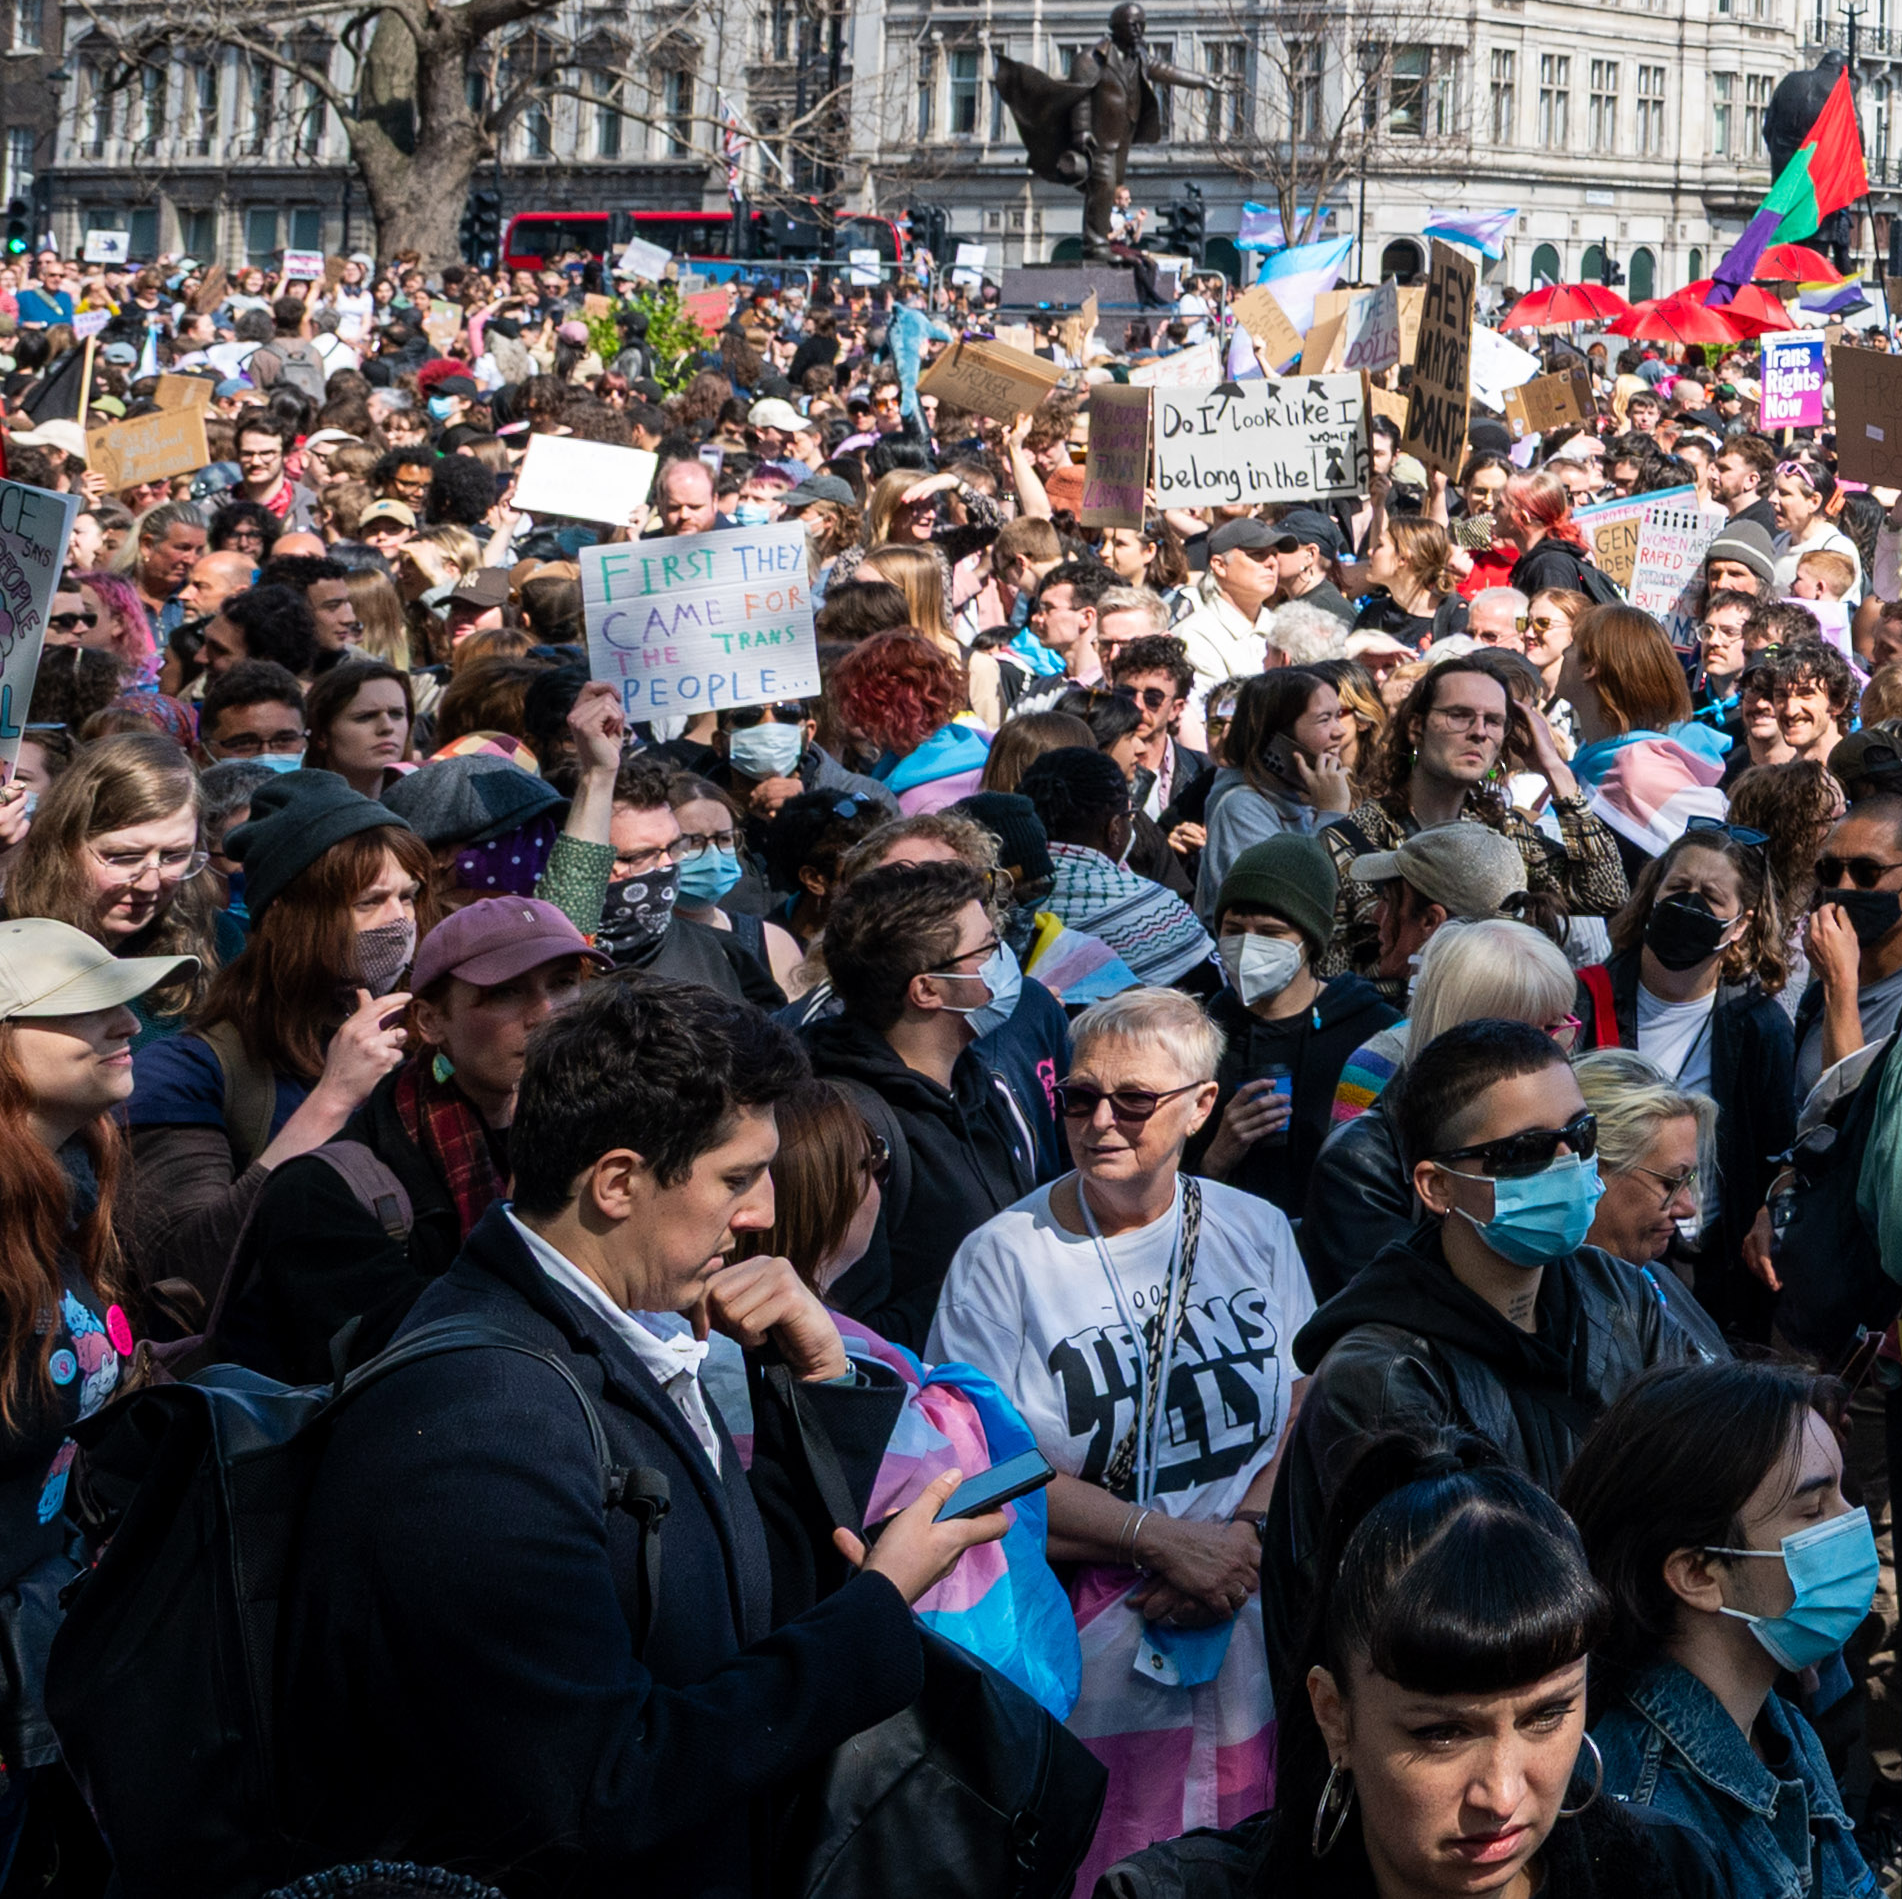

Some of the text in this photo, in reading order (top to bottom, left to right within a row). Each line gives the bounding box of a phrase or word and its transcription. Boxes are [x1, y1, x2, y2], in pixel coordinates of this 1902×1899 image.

[1425, 260, 1473, 336] HEY
[1345, 327, 1398, 368] DOLLS
[1416, 328, 1468, 393] MAYBE
[1764, 346, 1811, 368] Trans
[1765, 369, 1821, 397] Rights
[1163, 399, 1357, 438] Do I look like I
[1765, 396, 1803, 419] Now
[1309, 430, 1358, 443] WOMEN
[1159, 455, 1242, 502] belong
[1246, 461, 1271, 490] in
[1275, 461, 1309, 488] the
[23, 539, 53, 569] SAYS
[1640, 547, 1683, 570] RAPED
[1642, 533, 1688, 551] WOMEN
[600, 544, 803, 605] FIRST THEY
[1636, 590, 1664, 608] BUT
[602, 584, 805, 650] CAME FOR
[610, 625, 797, 676] THE TRANS
